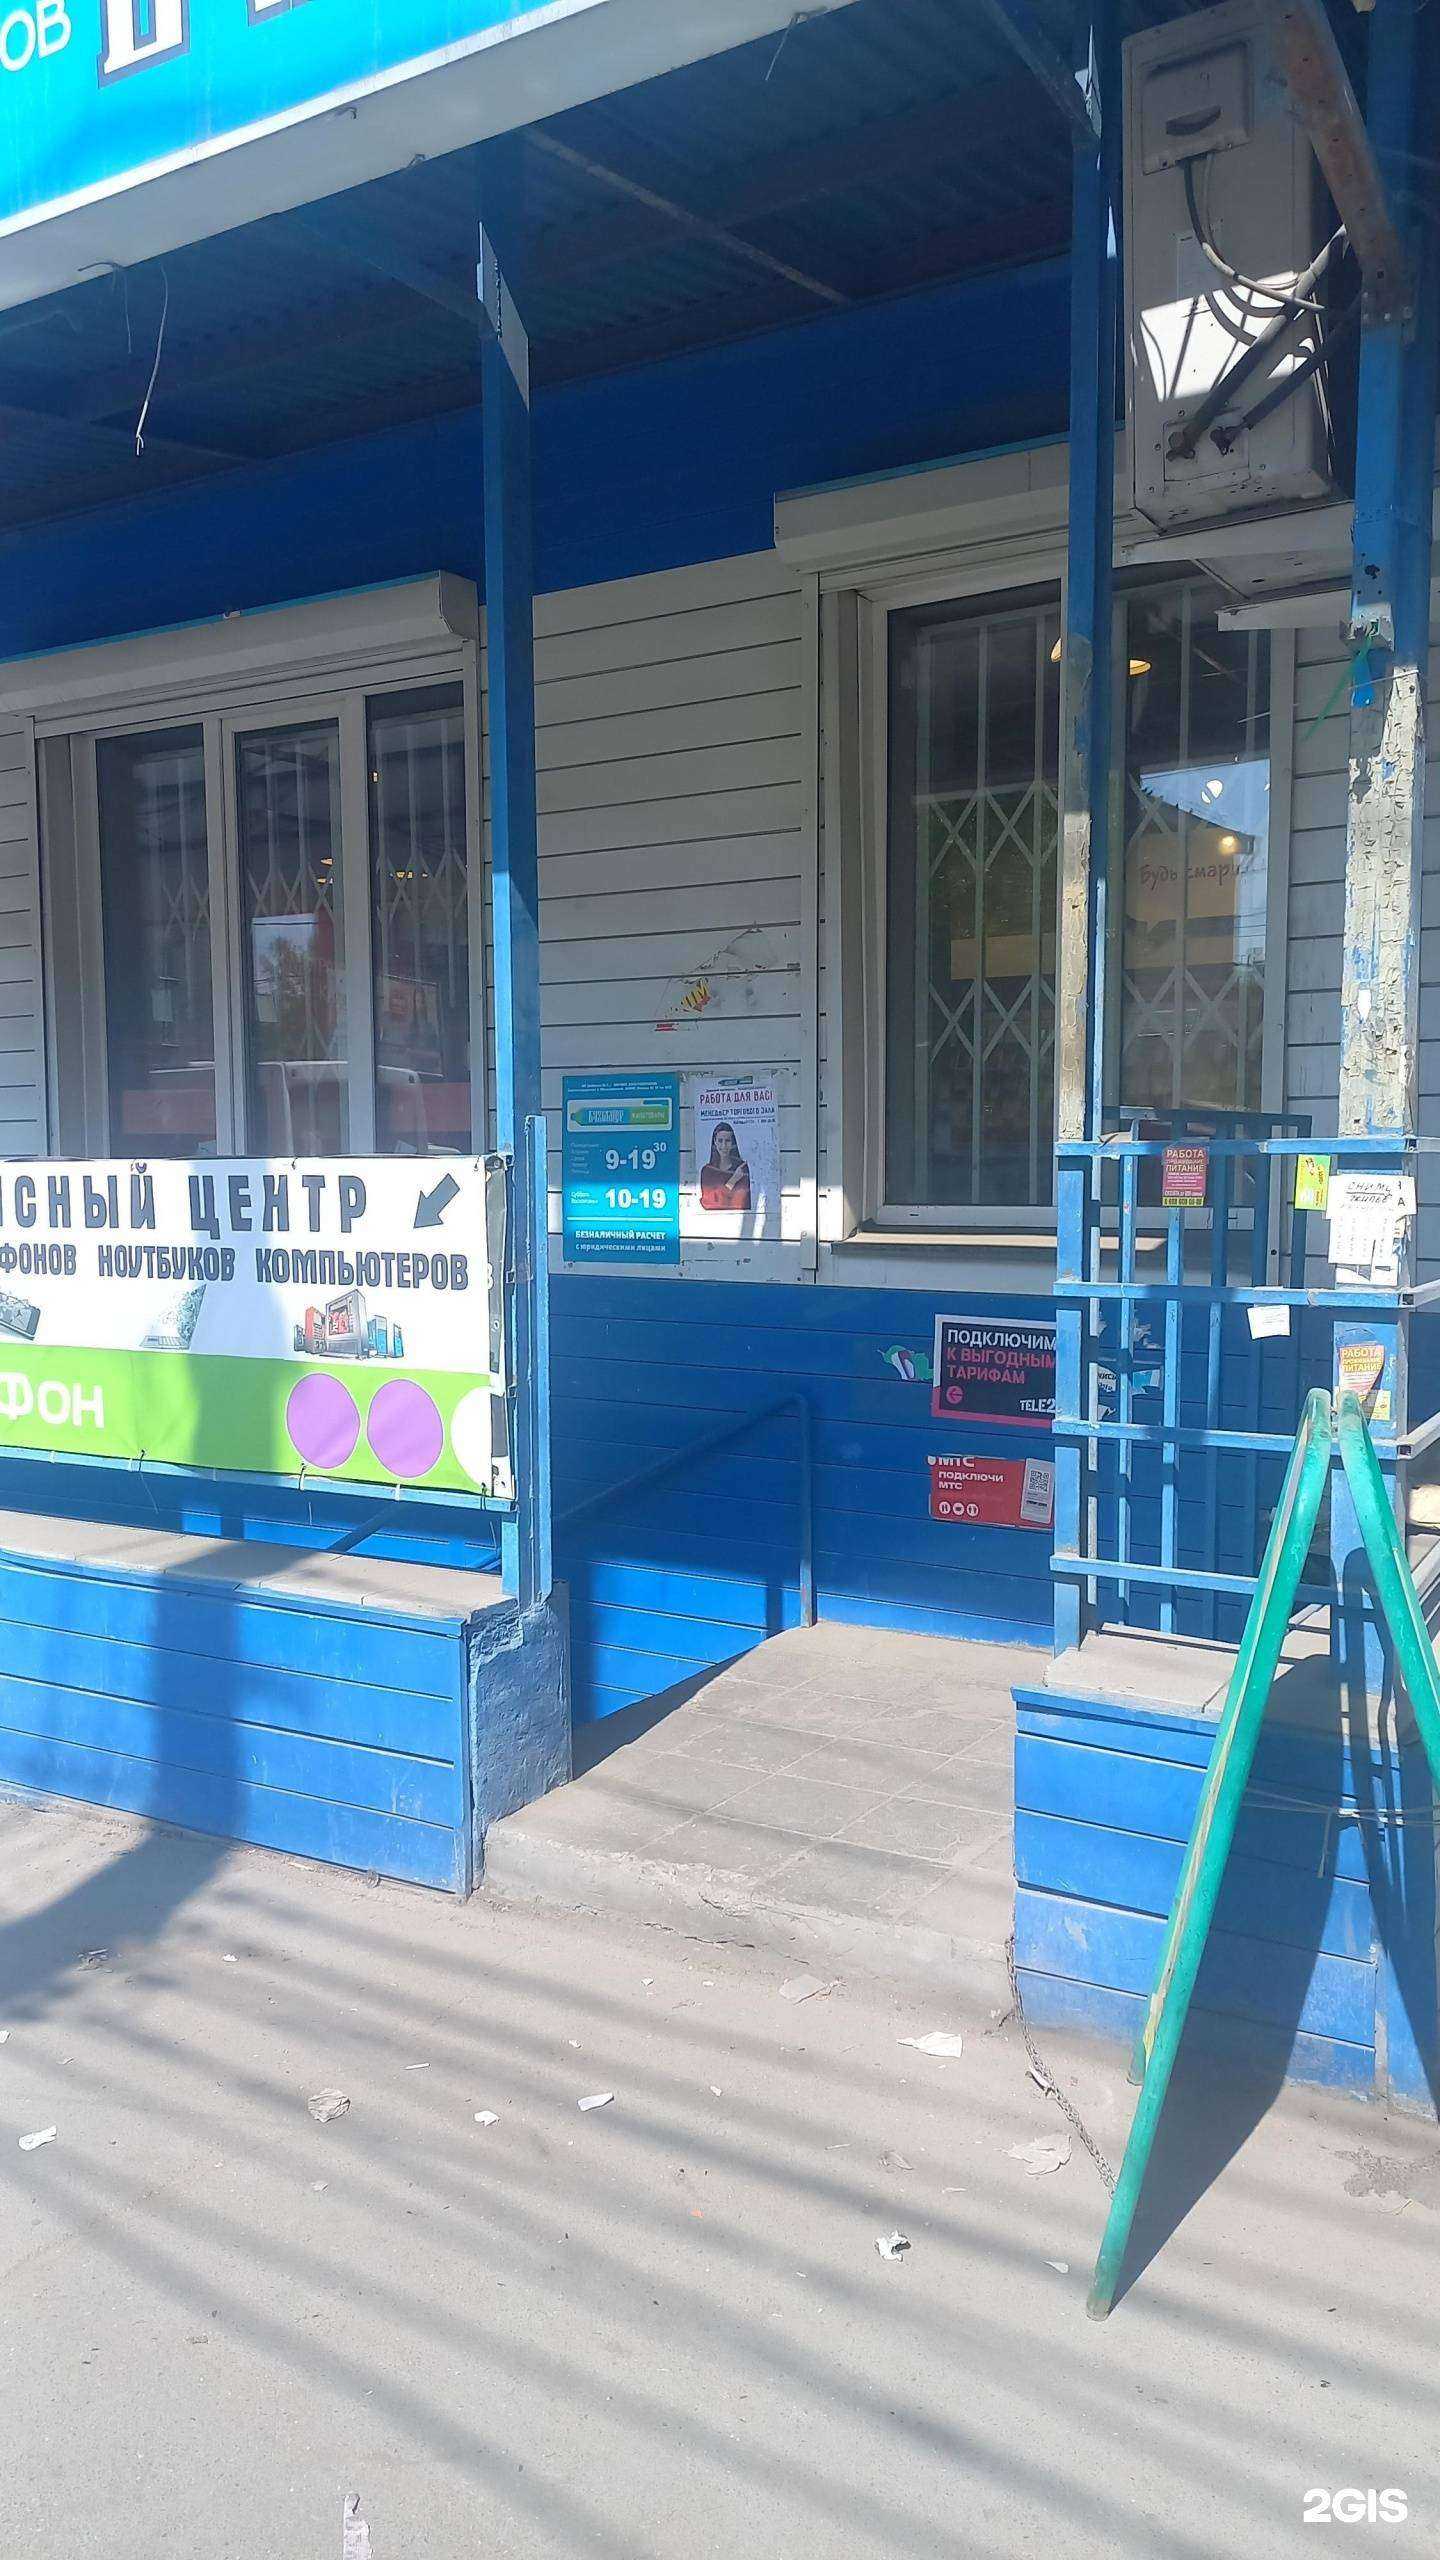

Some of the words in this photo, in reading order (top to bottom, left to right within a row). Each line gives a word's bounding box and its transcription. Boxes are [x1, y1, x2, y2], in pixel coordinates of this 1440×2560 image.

[699, 1093, 731, 1105] РАБОТА
[734, 1091, 751, 1103] ДЛЯ
[1166, 1149, 1205, 1159] РАБОТА
[1165, 1164, 1206, 1172] ПИТАНИЕ
[0, 1163, 155, 1229] СНЫЙ
[188, 1175, 367, 1240] ЦЕНТР
[605, 1188, 667, 1208] 10-19
[575, 1229, 635, 1239] БЕЗНАЛИЧНЫЙ
[636, 1232, 666, 1240] РАСЧЕТ
[0, 1243, 76, 1275] ФОНОВ
[98, 1245, 236, 1282] НОУТБУКОВ
[255, 1248, 469, 1291] КОМПЬЮТЕРОВ
[947, 1329, 1056, 1350] ПОДКЛЮЧИМ
[946, 1347, 956, 1360] К
[1342, 1348, 1383, 1358] РАБОТА
[1343, 1361, 1382, 1372] ПИТАНИЕ
[946, 1364, 1025, 1385] ТАРИФАМ
[0, 1371, 104, 1429] ФОН
[1019, 1398, 1056, 1414] TELE2
[938, 1481, 963, 1490] МТС
